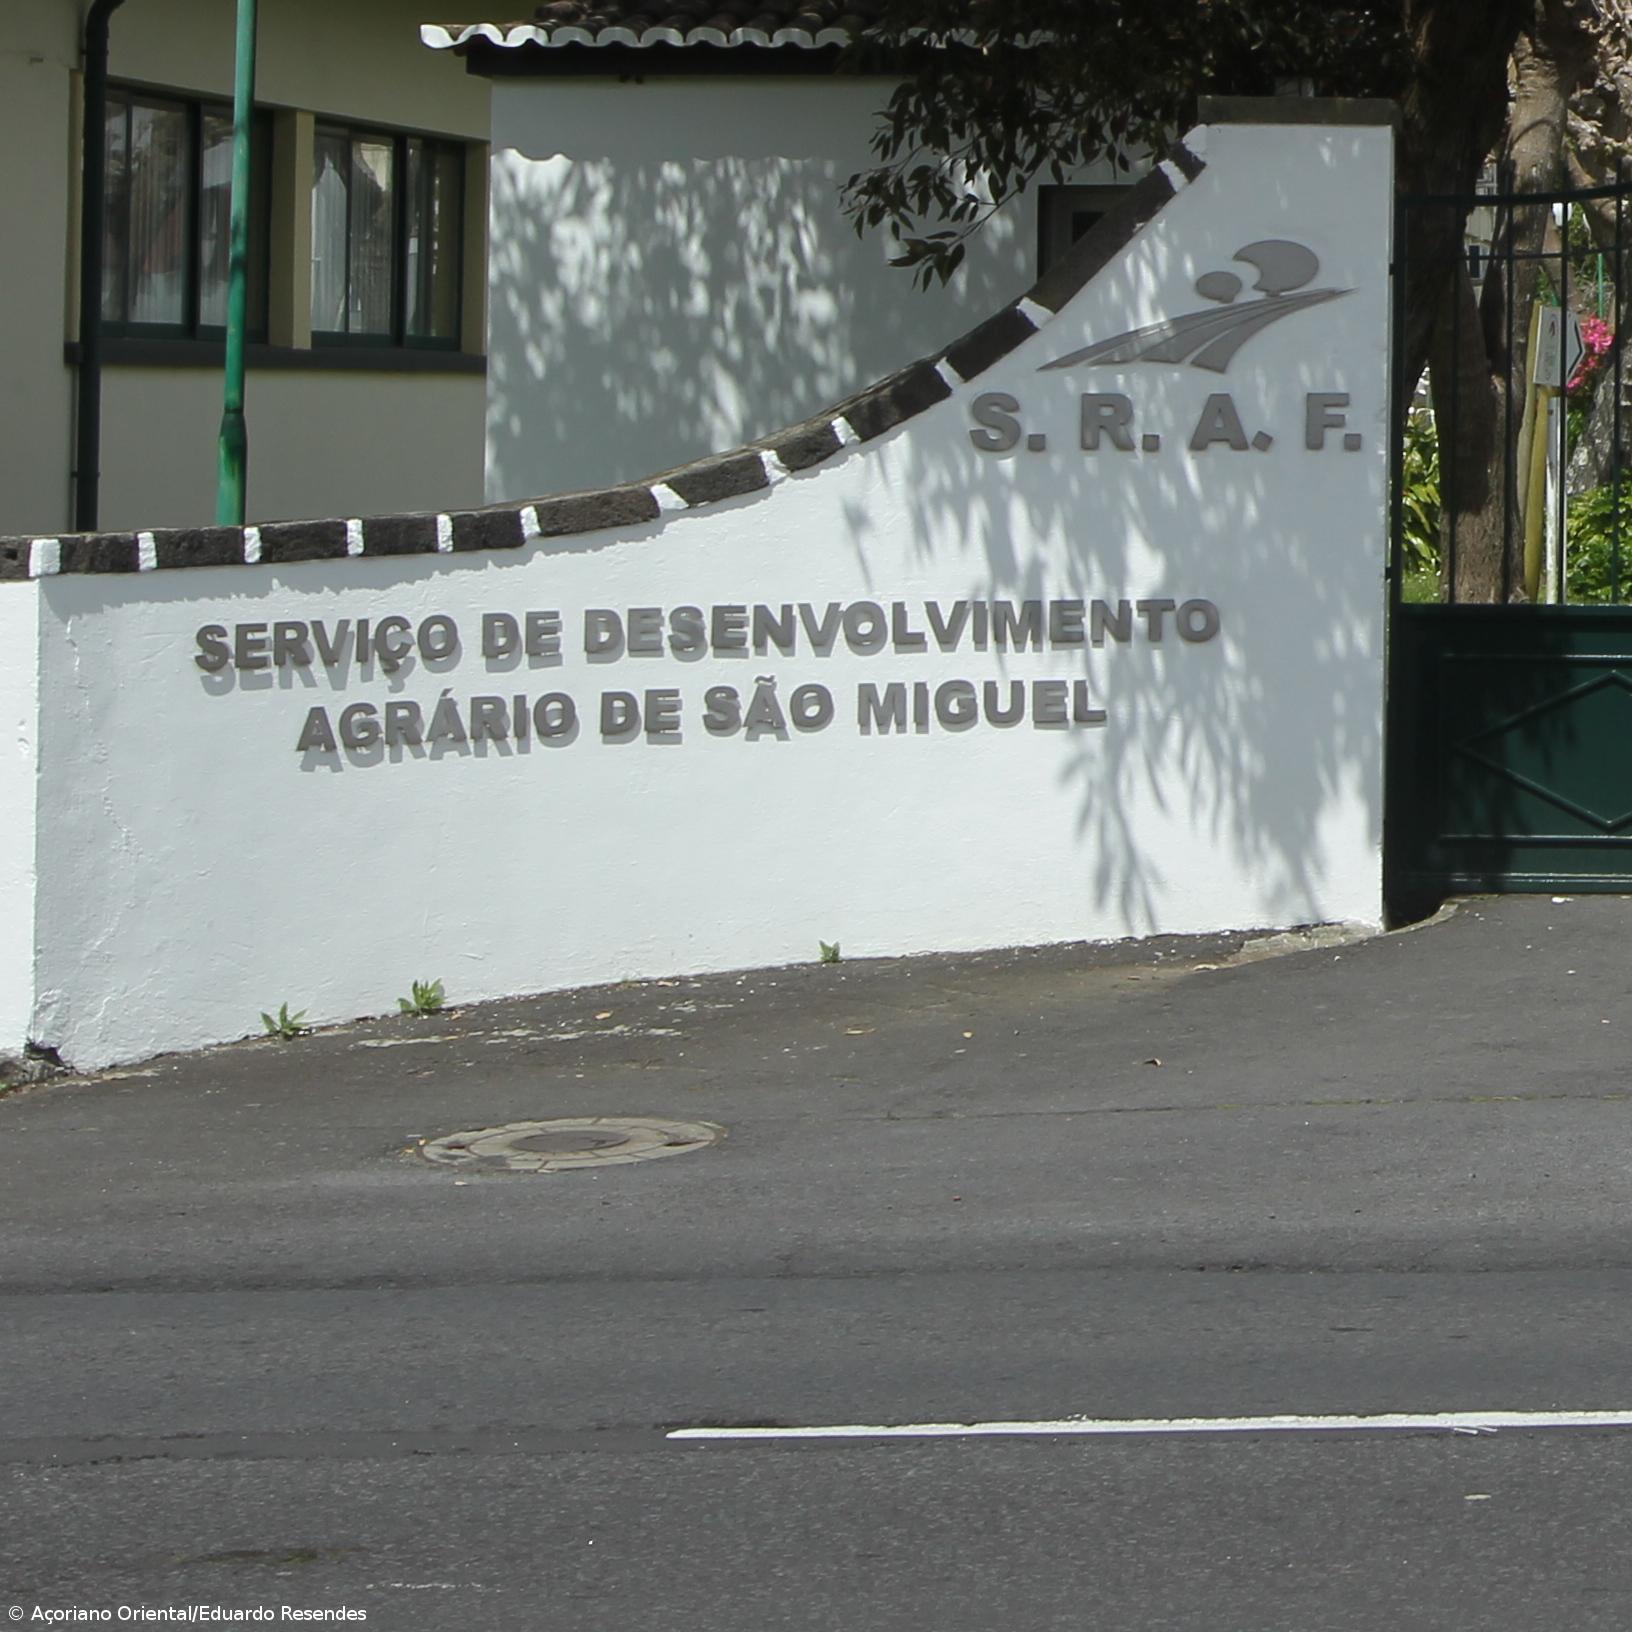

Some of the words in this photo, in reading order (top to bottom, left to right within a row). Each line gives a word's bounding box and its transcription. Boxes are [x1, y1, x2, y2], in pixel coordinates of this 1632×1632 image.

[194, 614, 460, 678] SERVIÇO
[482, 610, 562, 659] DE
[584, 599, 1221, 655] DESENVOLVIMENTO
[297, 687, 577, 753] AGRÁRIO
[600, 689, 681, 736] DE
[703, 675, 835, 732] SÃO
[857, 678, 1108, 727] MIGUEL
